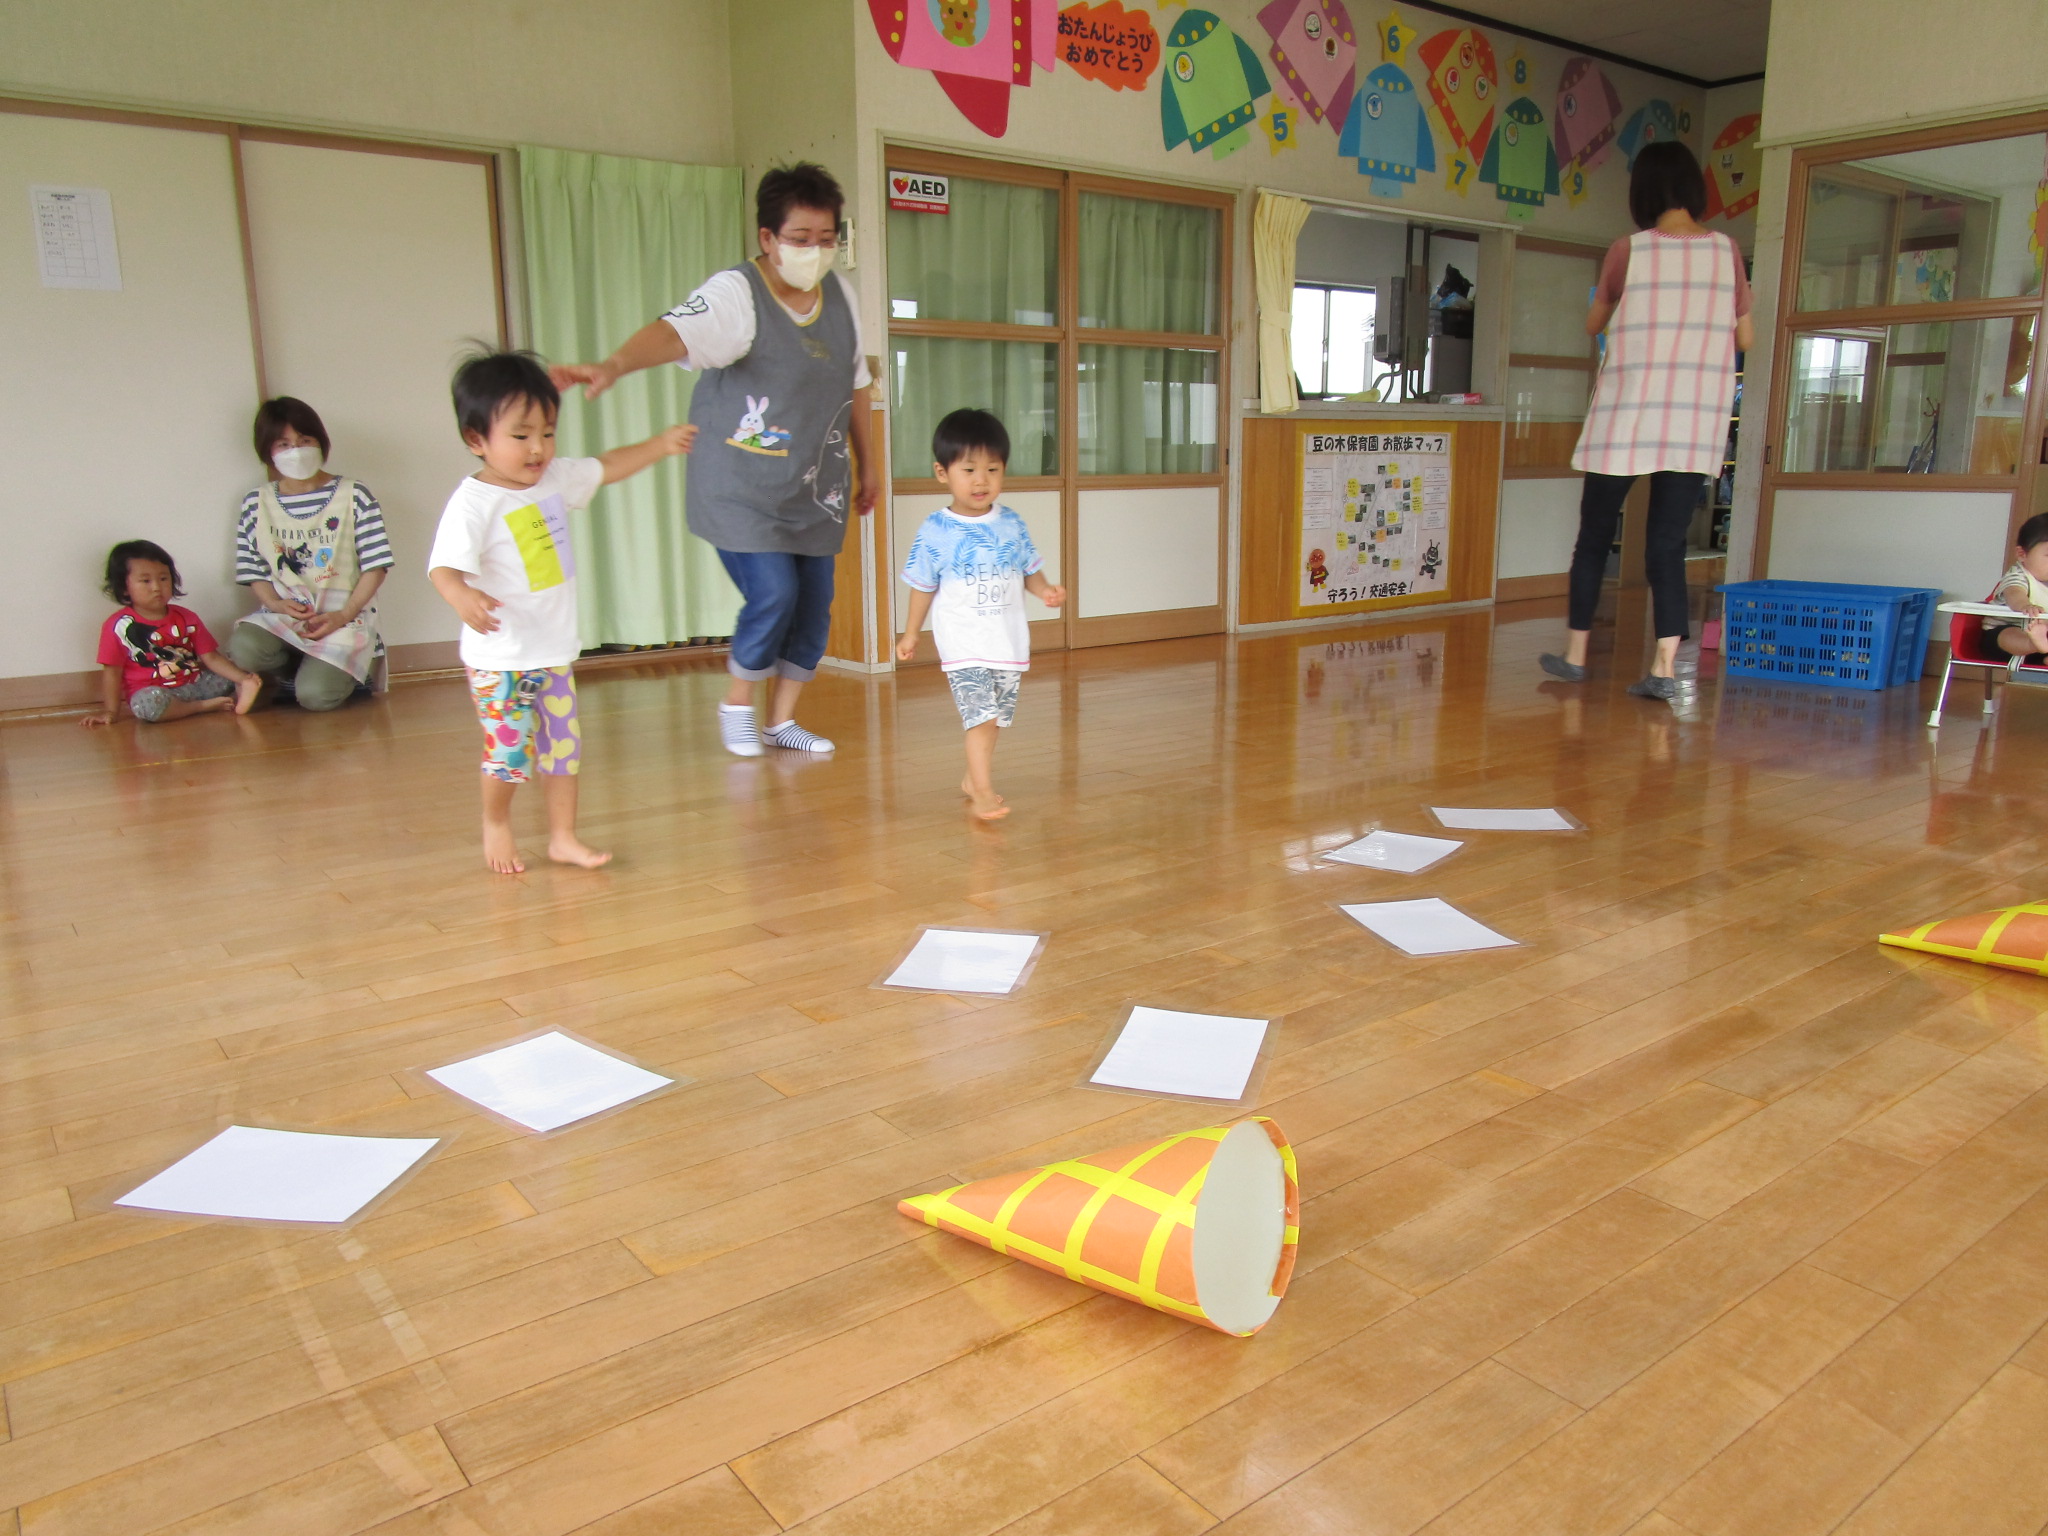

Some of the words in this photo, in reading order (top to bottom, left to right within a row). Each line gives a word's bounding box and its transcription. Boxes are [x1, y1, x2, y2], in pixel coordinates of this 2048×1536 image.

[1058, 13, 1154, 52] おたんじょうび
[1387, 25, 1400, 53] 6
[1066, 42, 1143, 73] おめでとう
[1514, 59, 1526, 84] 8
[1272, 112, 1288, 142] 5
[1677, 108, 1691, 134] 10
[1455, 159, 1467, 185] 7
[1573, 172, 1583, 195] 9
[909, 179, 946, 196] AED
[1312, 435, 1379, 452] 豆の木保育園
[1383, 435, 1443, 452] お散歩マップ
[978, 583, 1010, 605] BOY
